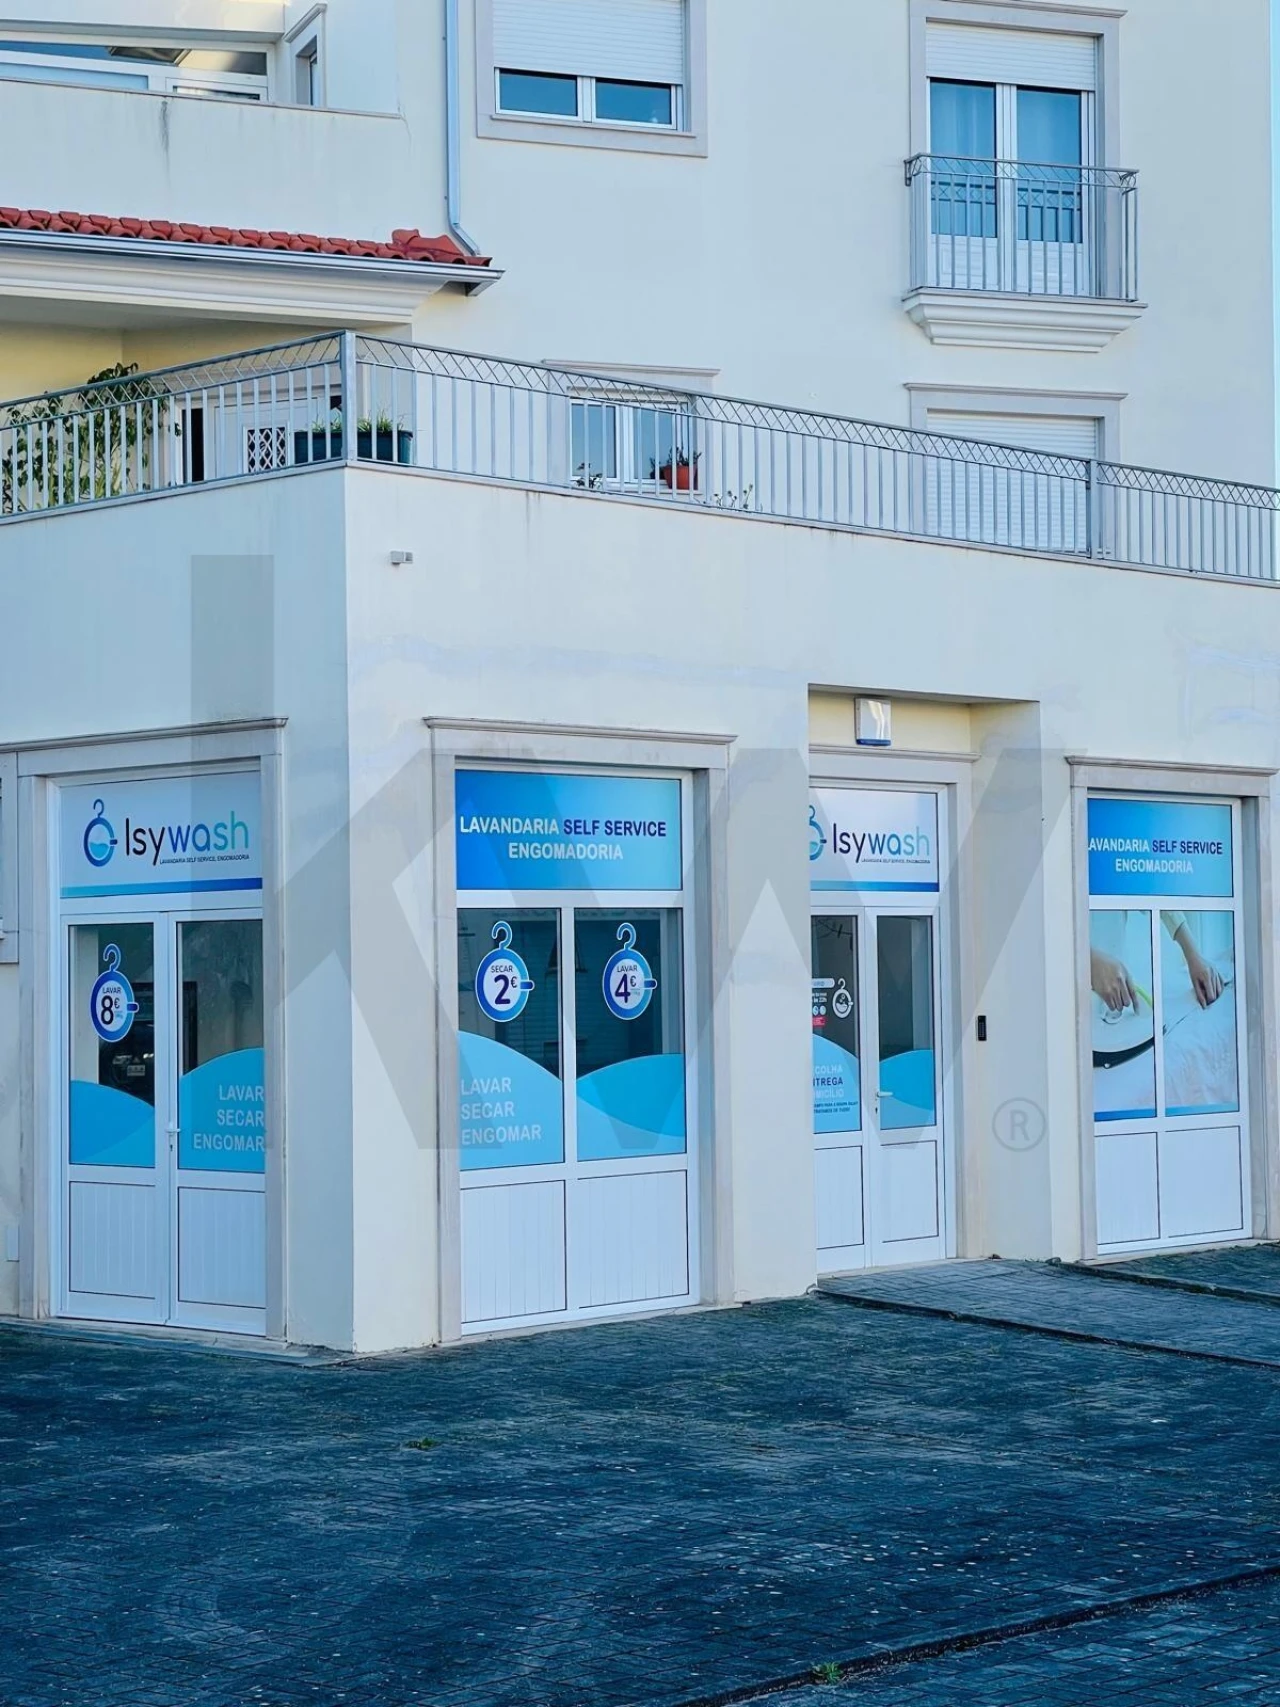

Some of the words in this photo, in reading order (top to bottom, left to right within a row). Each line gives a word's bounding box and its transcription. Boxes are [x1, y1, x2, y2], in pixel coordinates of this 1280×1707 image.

[460, 816, 559, 835] LAVANDARIA
[563, 819, 600, 836] SELF
[604, 820, 666, 837] SERVICE
[125, 810, 249, 866] Isywash
[833, 822, 930, 864] Isywash
[1087, 838, 1149, 853] AVANDARIA
[1152, 840, 1177, 853] SELF
[1180, 841, 1223, 855] SERVICE
[508, 842, 624, 860] ENGOMADORIA
[1115, 858, 1194, 874] ENGOMADORIA
[490, 964, 513, 973] SECAR
[616, 965, 638, 973] LAVAR
[102, 986, 122, 994] LAVAR
[218, 1085, 264, 1102] LAVAR
[461, 1077, 512, 1095] LAVAR
[216, 1109, 264, 1127] SECAR
[461, 1101, 515, 1120] SECAR
[193, 1133, 265, 1152] ENGOMAR
[461, 1124, 542, 1145] ENGOMAR
